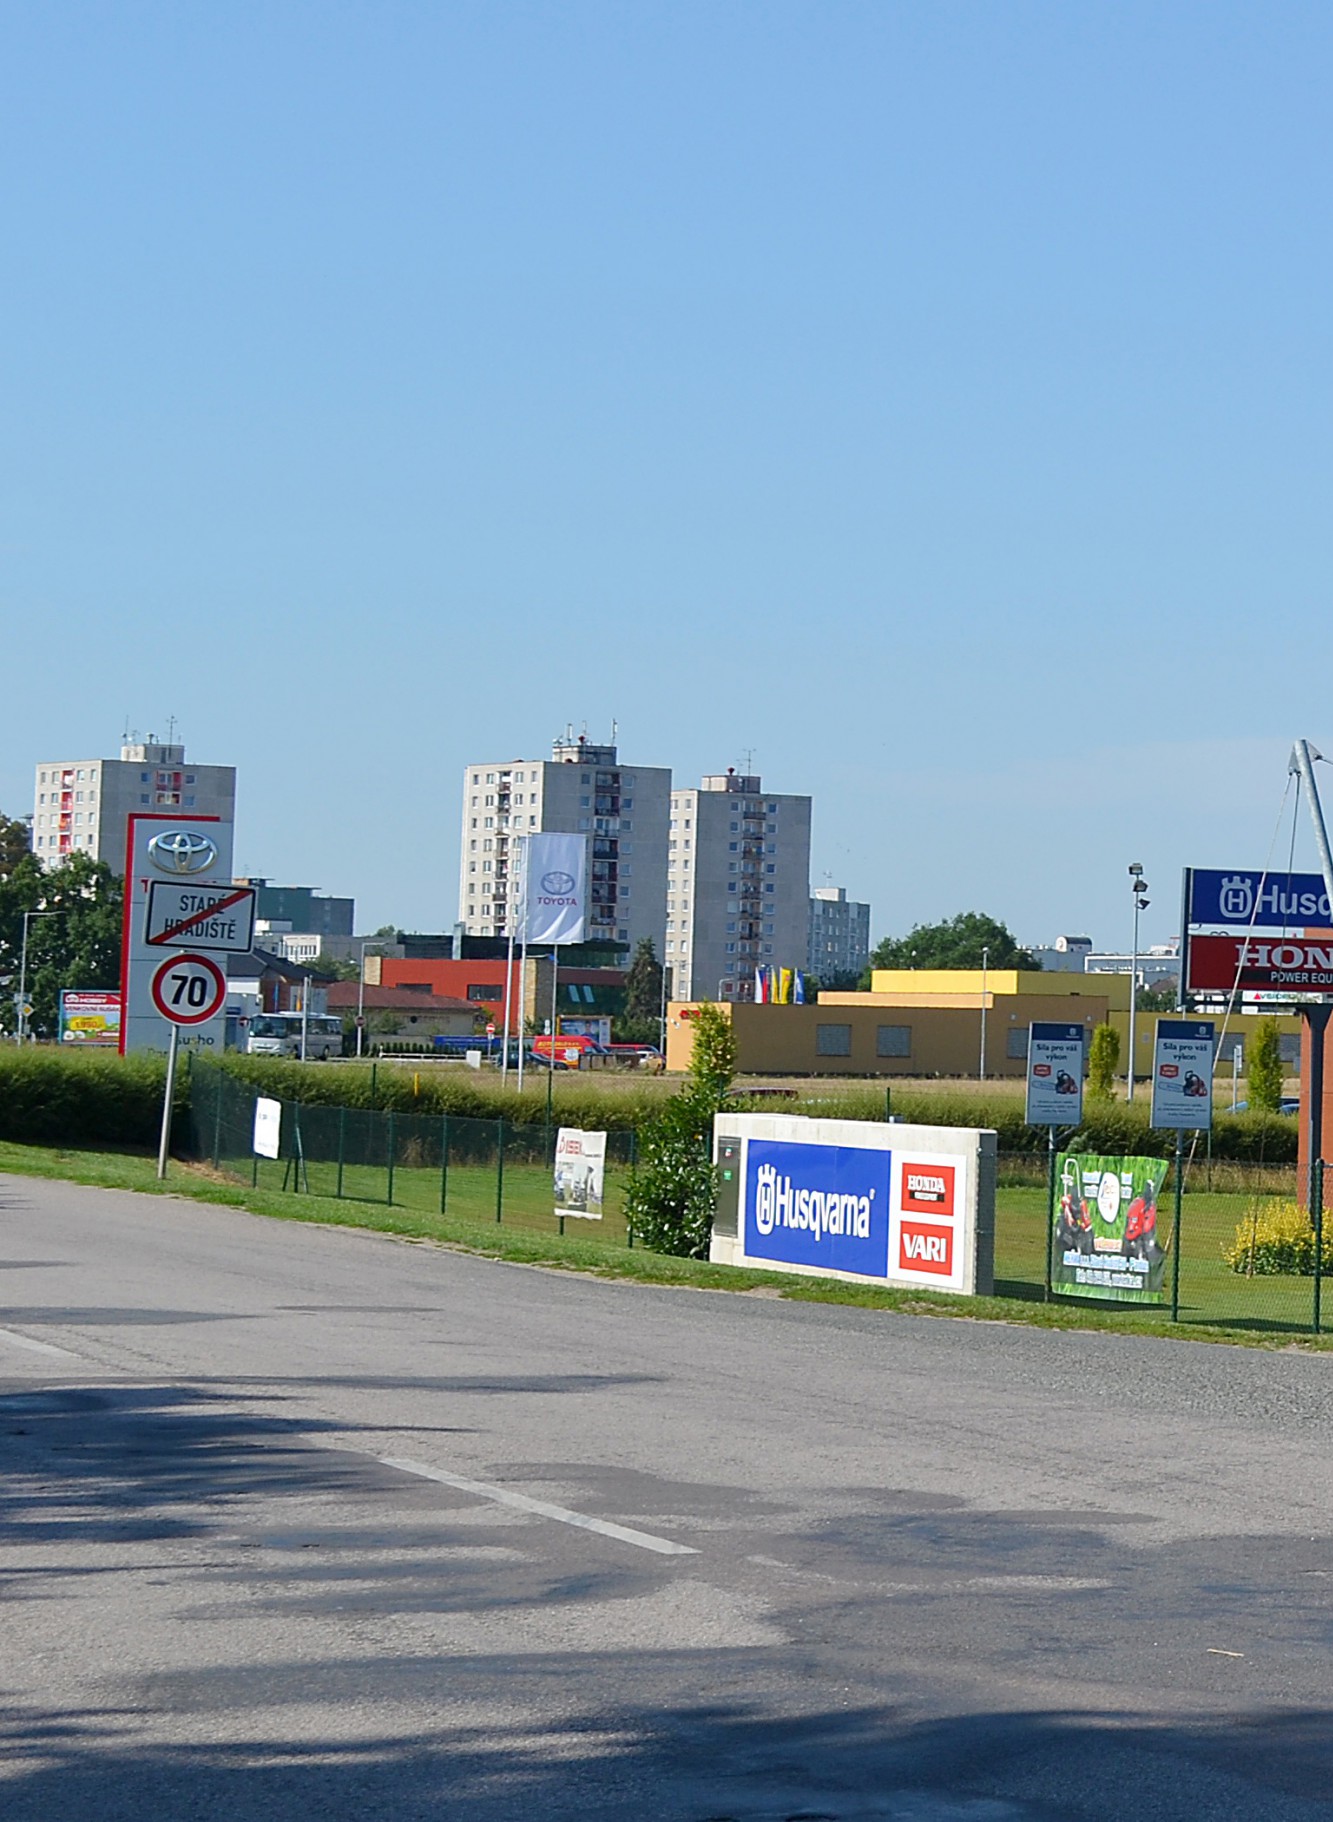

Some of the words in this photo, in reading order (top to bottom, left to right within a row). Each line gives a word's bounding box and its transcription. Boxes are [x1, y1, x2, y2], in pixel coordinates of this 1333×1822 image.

[180, 893, 226, 914] STARÉ
[537, 896, 577, 906] TOYOTA
[164, 917, 236, 940] HRADIŠTĚ
[1271, 971, 1309, 983] POWER
[171, 974, 207, 1007] 70
[907, 1174, 946, 1193] HONDA
[775, 1175, 870, 1242] Husqvarna
[902, 1233, 947, 1263] VARI
